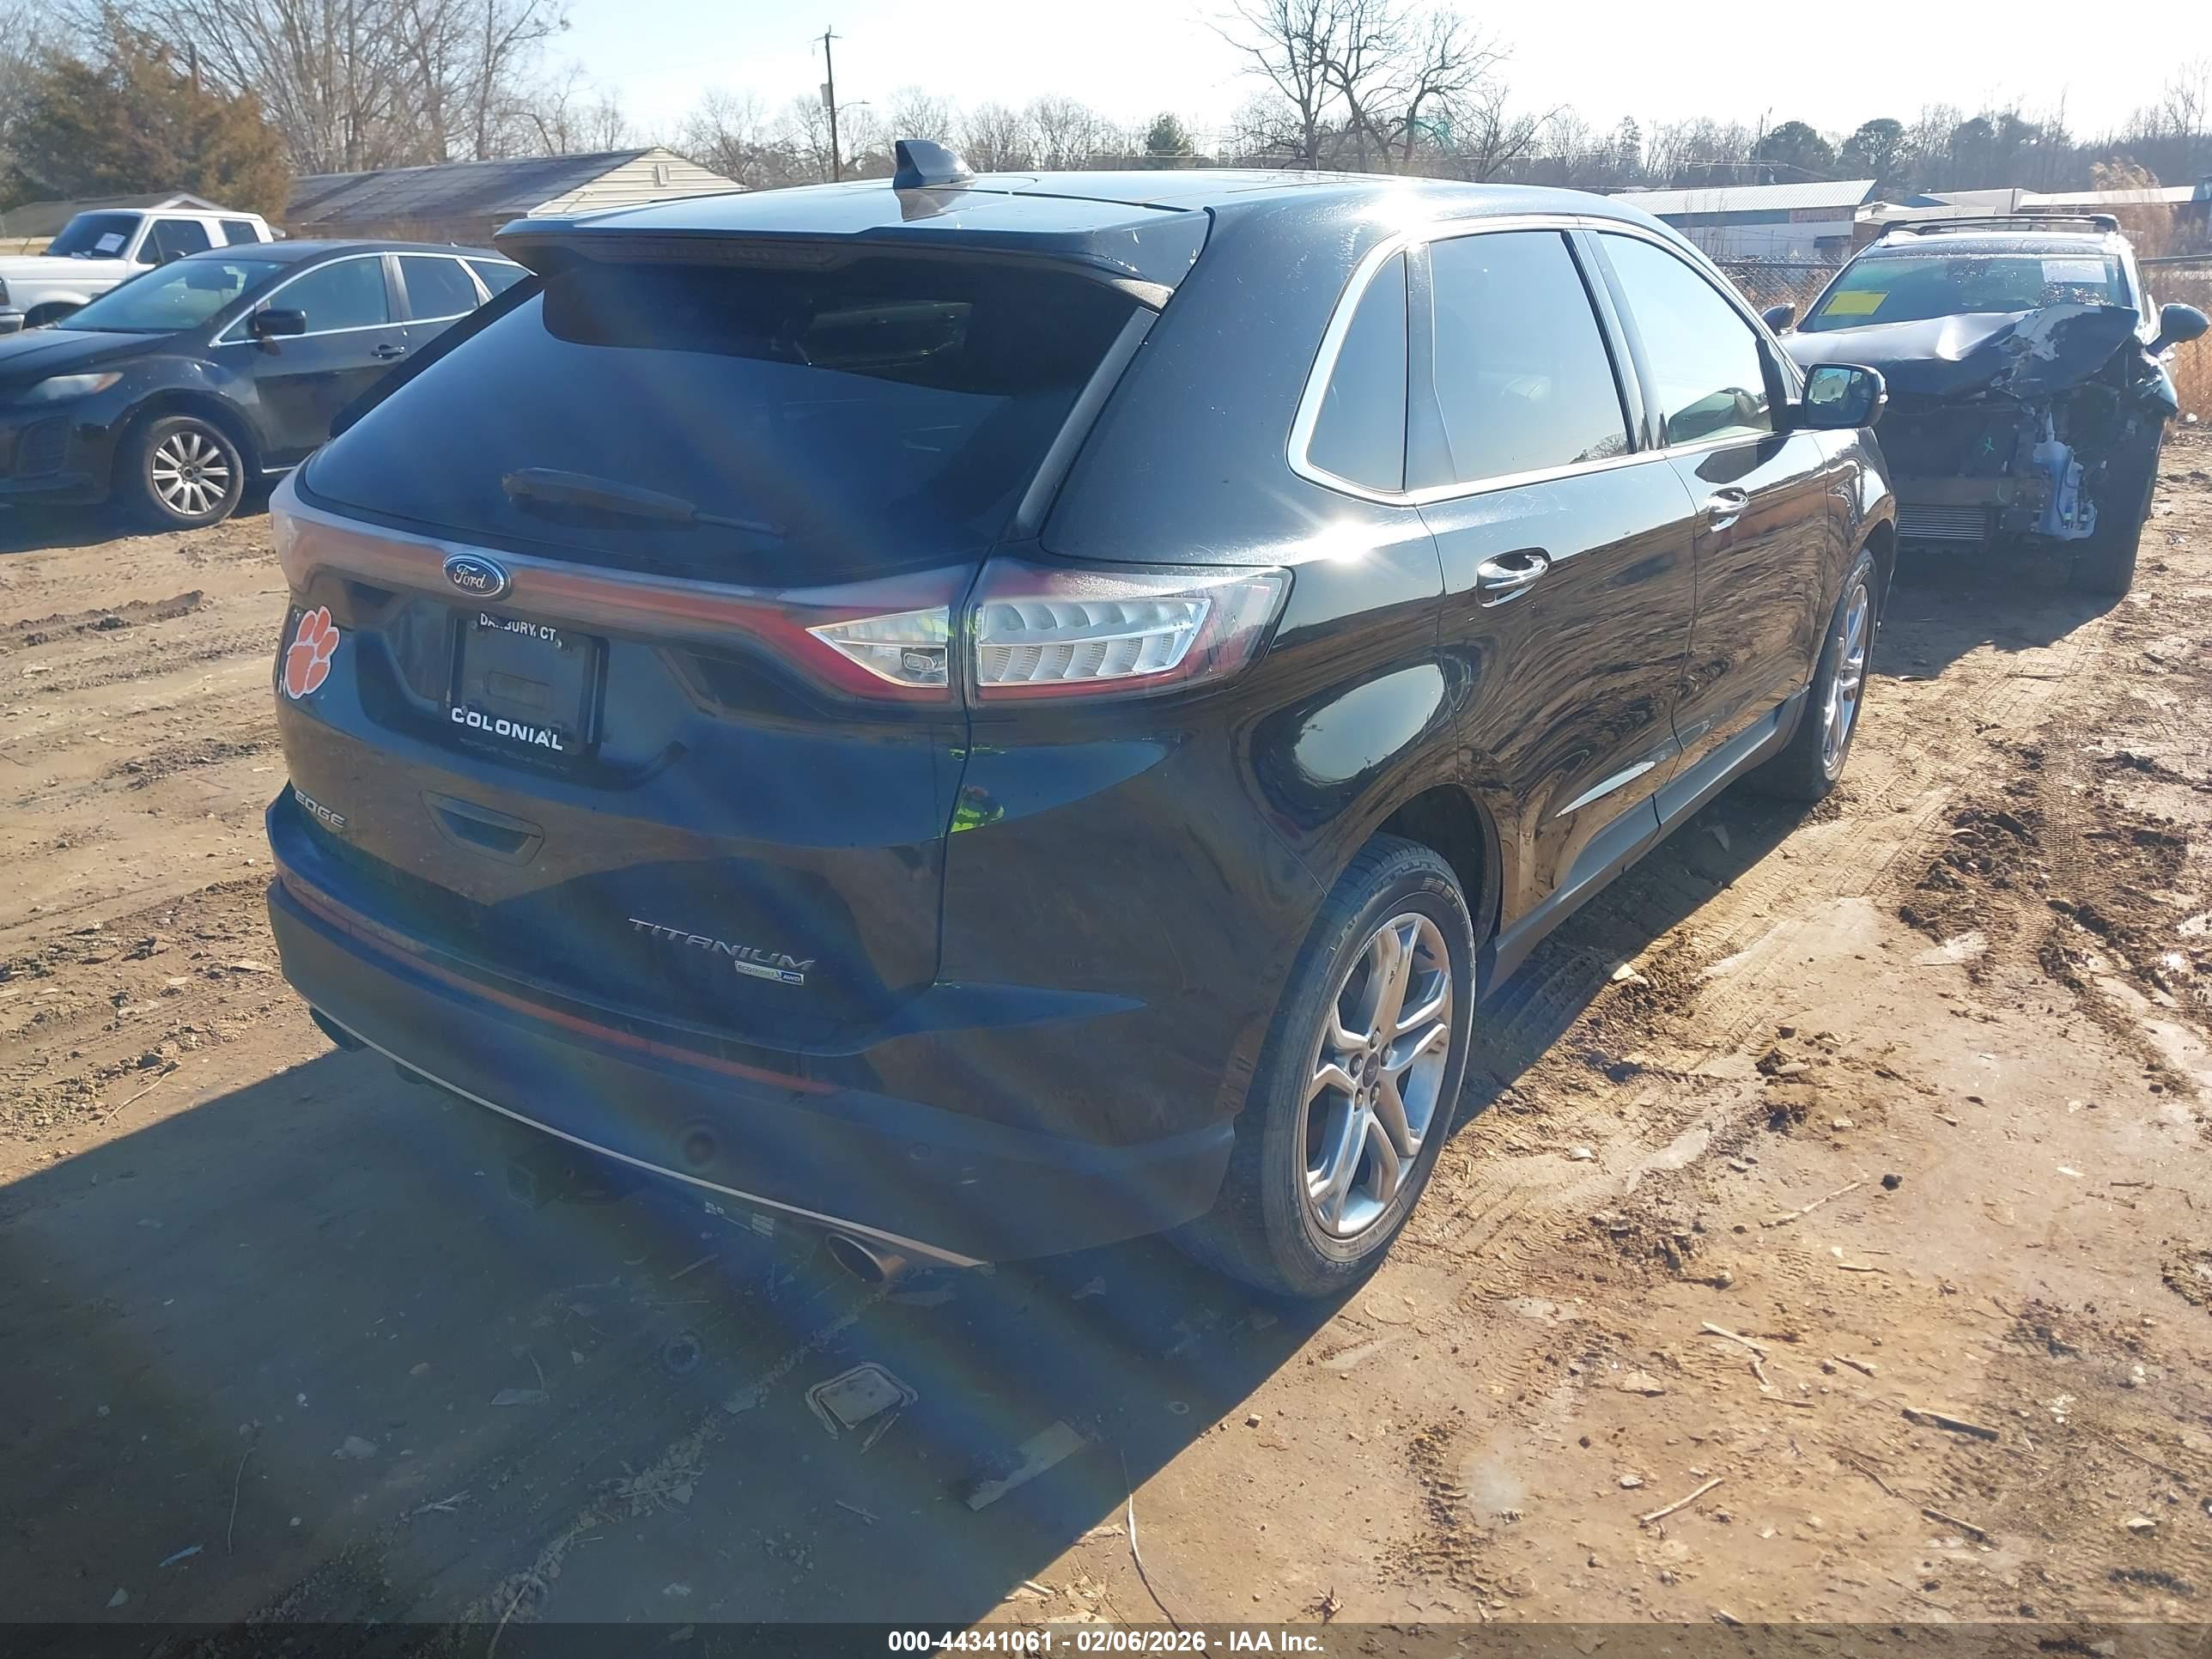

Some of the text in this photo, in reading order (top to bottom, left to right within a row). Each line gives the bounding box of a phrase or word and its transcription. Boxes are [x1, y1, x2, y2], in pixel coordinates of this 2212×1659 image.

[453, 563, 487, 589] Ford
[480, 612, 556, 641] DABURY, CT
[451, 707, 564, 751] COLONIAL
[295, 789, 346, 829] EDGE
[628, 917, 815, 971] TITANIUM
[782, 974, 800, 982] AWD
